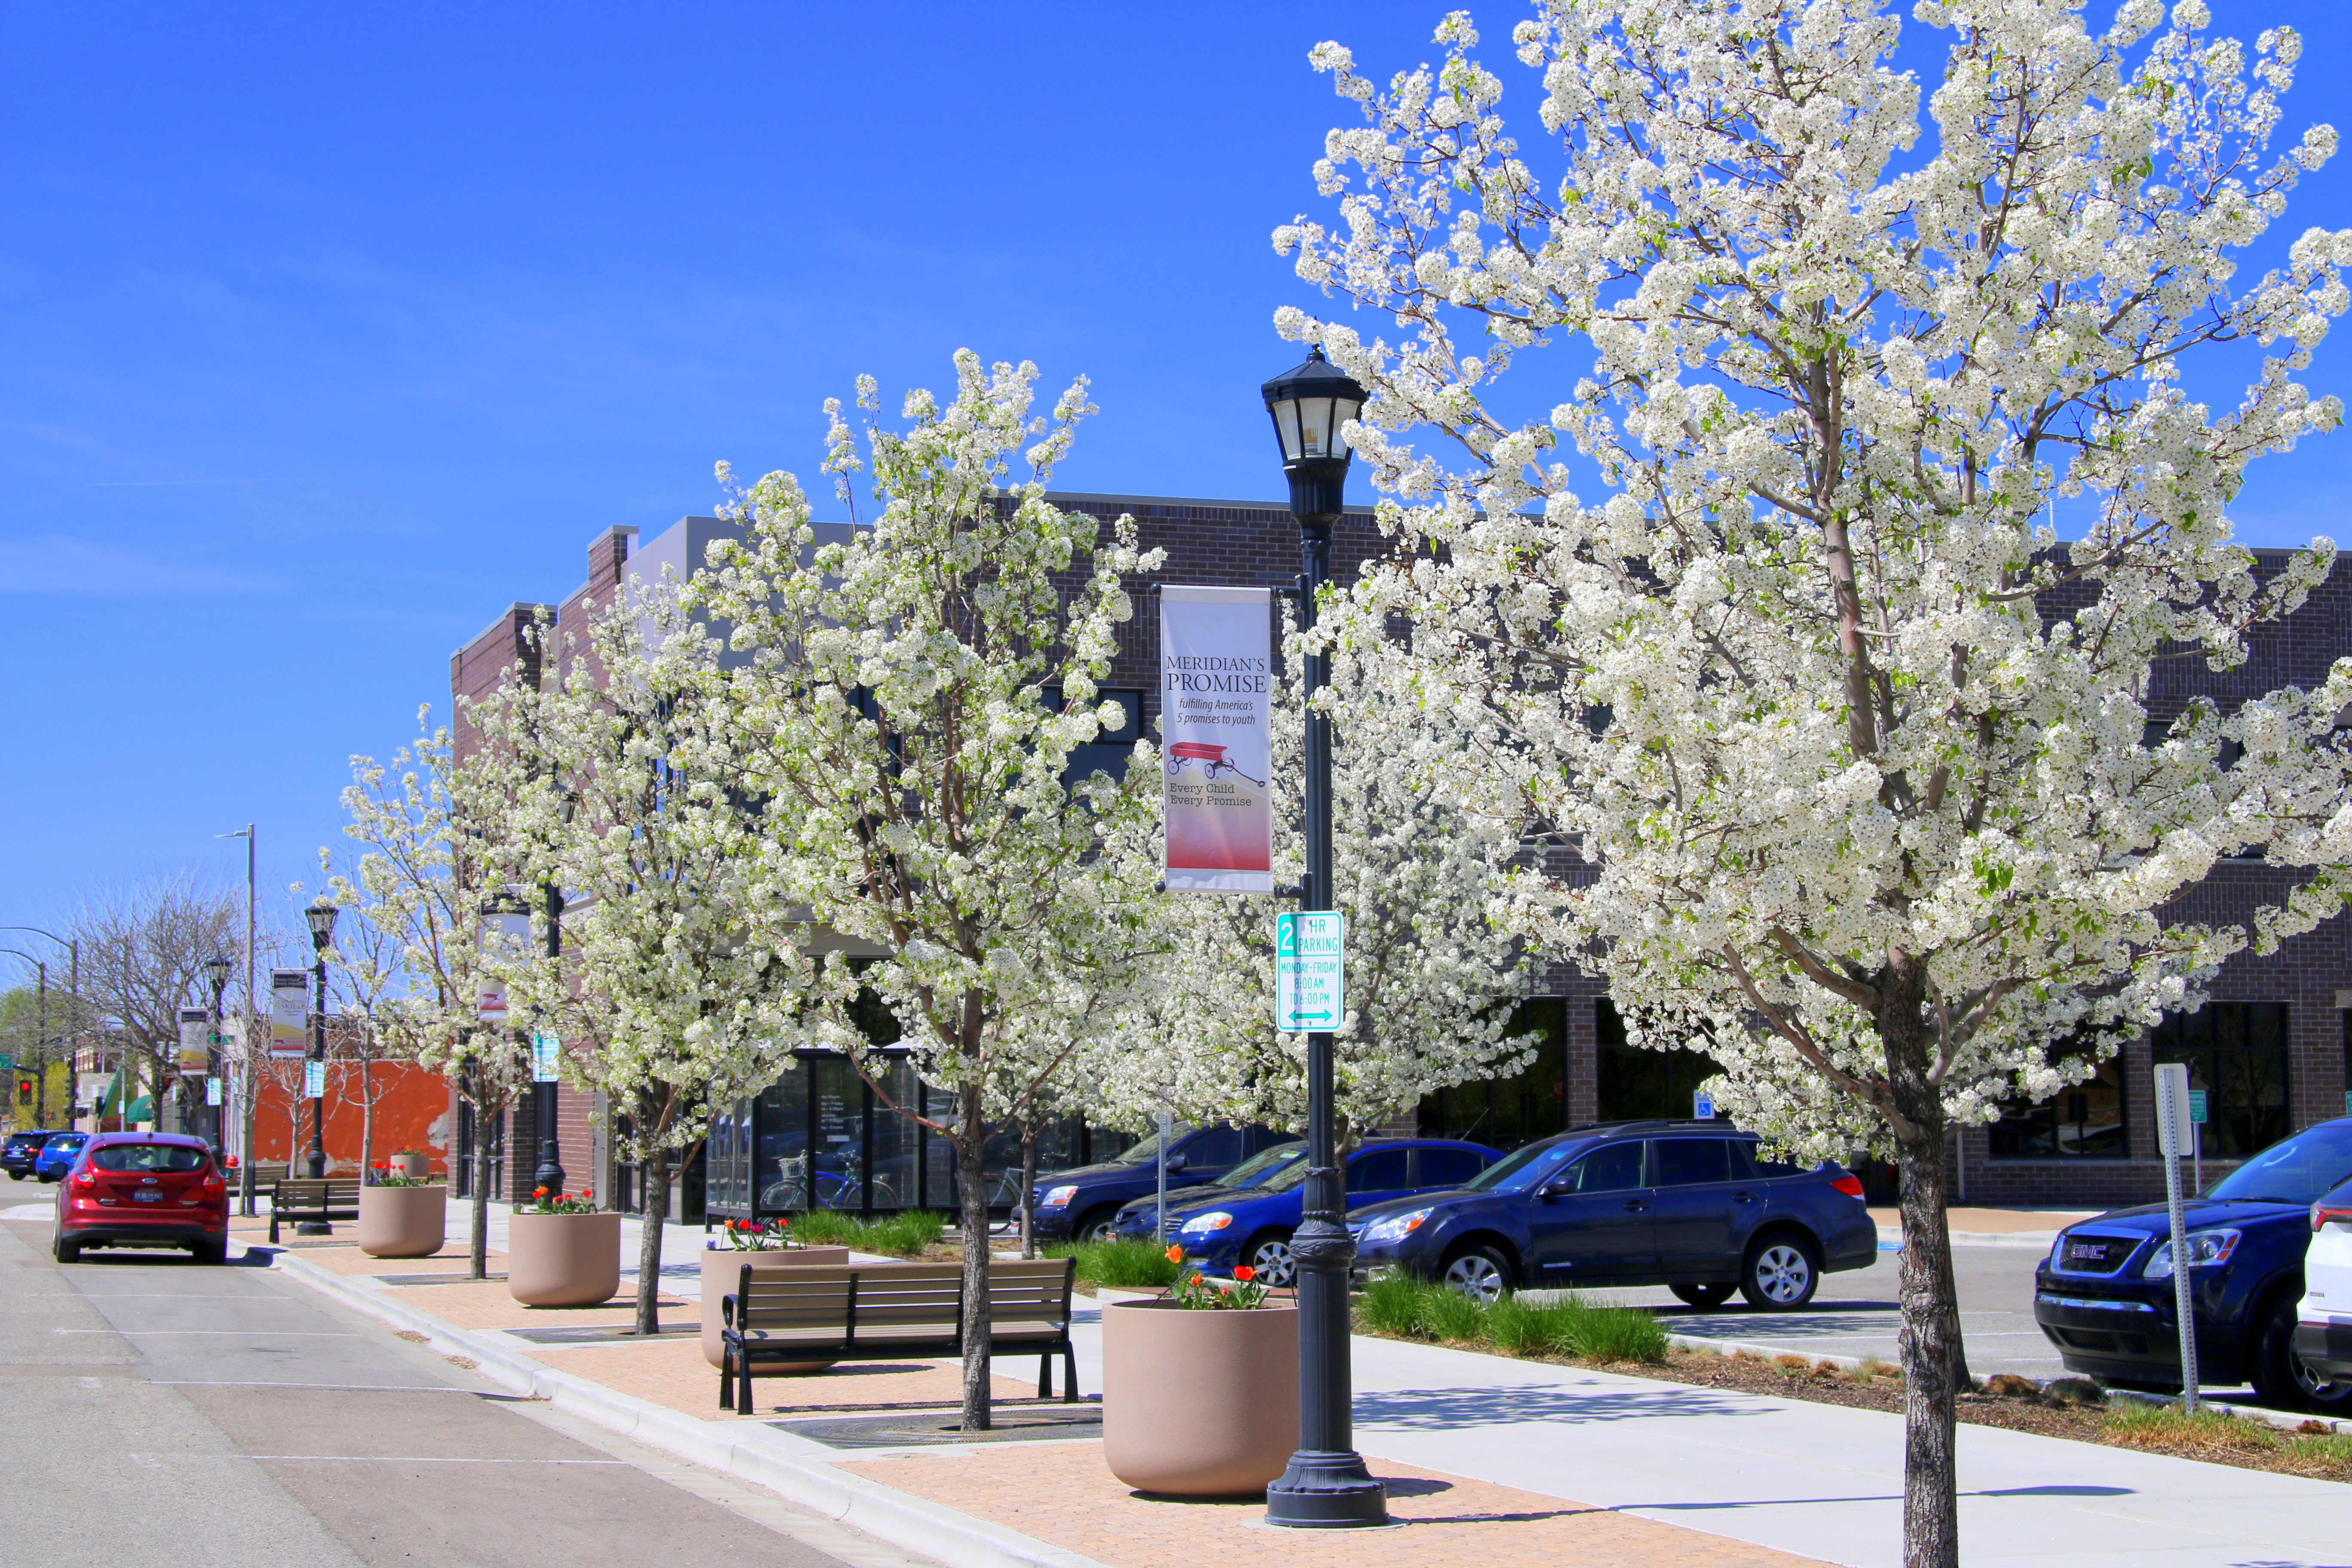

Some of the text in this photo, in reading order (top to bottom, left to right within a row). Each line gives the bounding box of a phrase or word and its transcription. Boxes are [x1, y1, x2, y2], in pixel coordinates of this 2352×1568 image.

[1167, 656, 1265, 672] MERIDIAN'S
[1167, 673, 1267, 693] PROMISE
[1179, 698, 1253, 712] fulfilling America's
[1177, 713, 1256, 727] 5 promises to youth
[1170, 783, 1235, 795] Every Child
[1170, 795, 1252, 807] Every Promise
[1280, 919, 1326, 950] 2 HR
[1298, 937, 1338, 952] PARKING
[1289, 992, 1329, 1004] TO 6:00 PM
[2071, 1244, 2107, 1260] GMC
